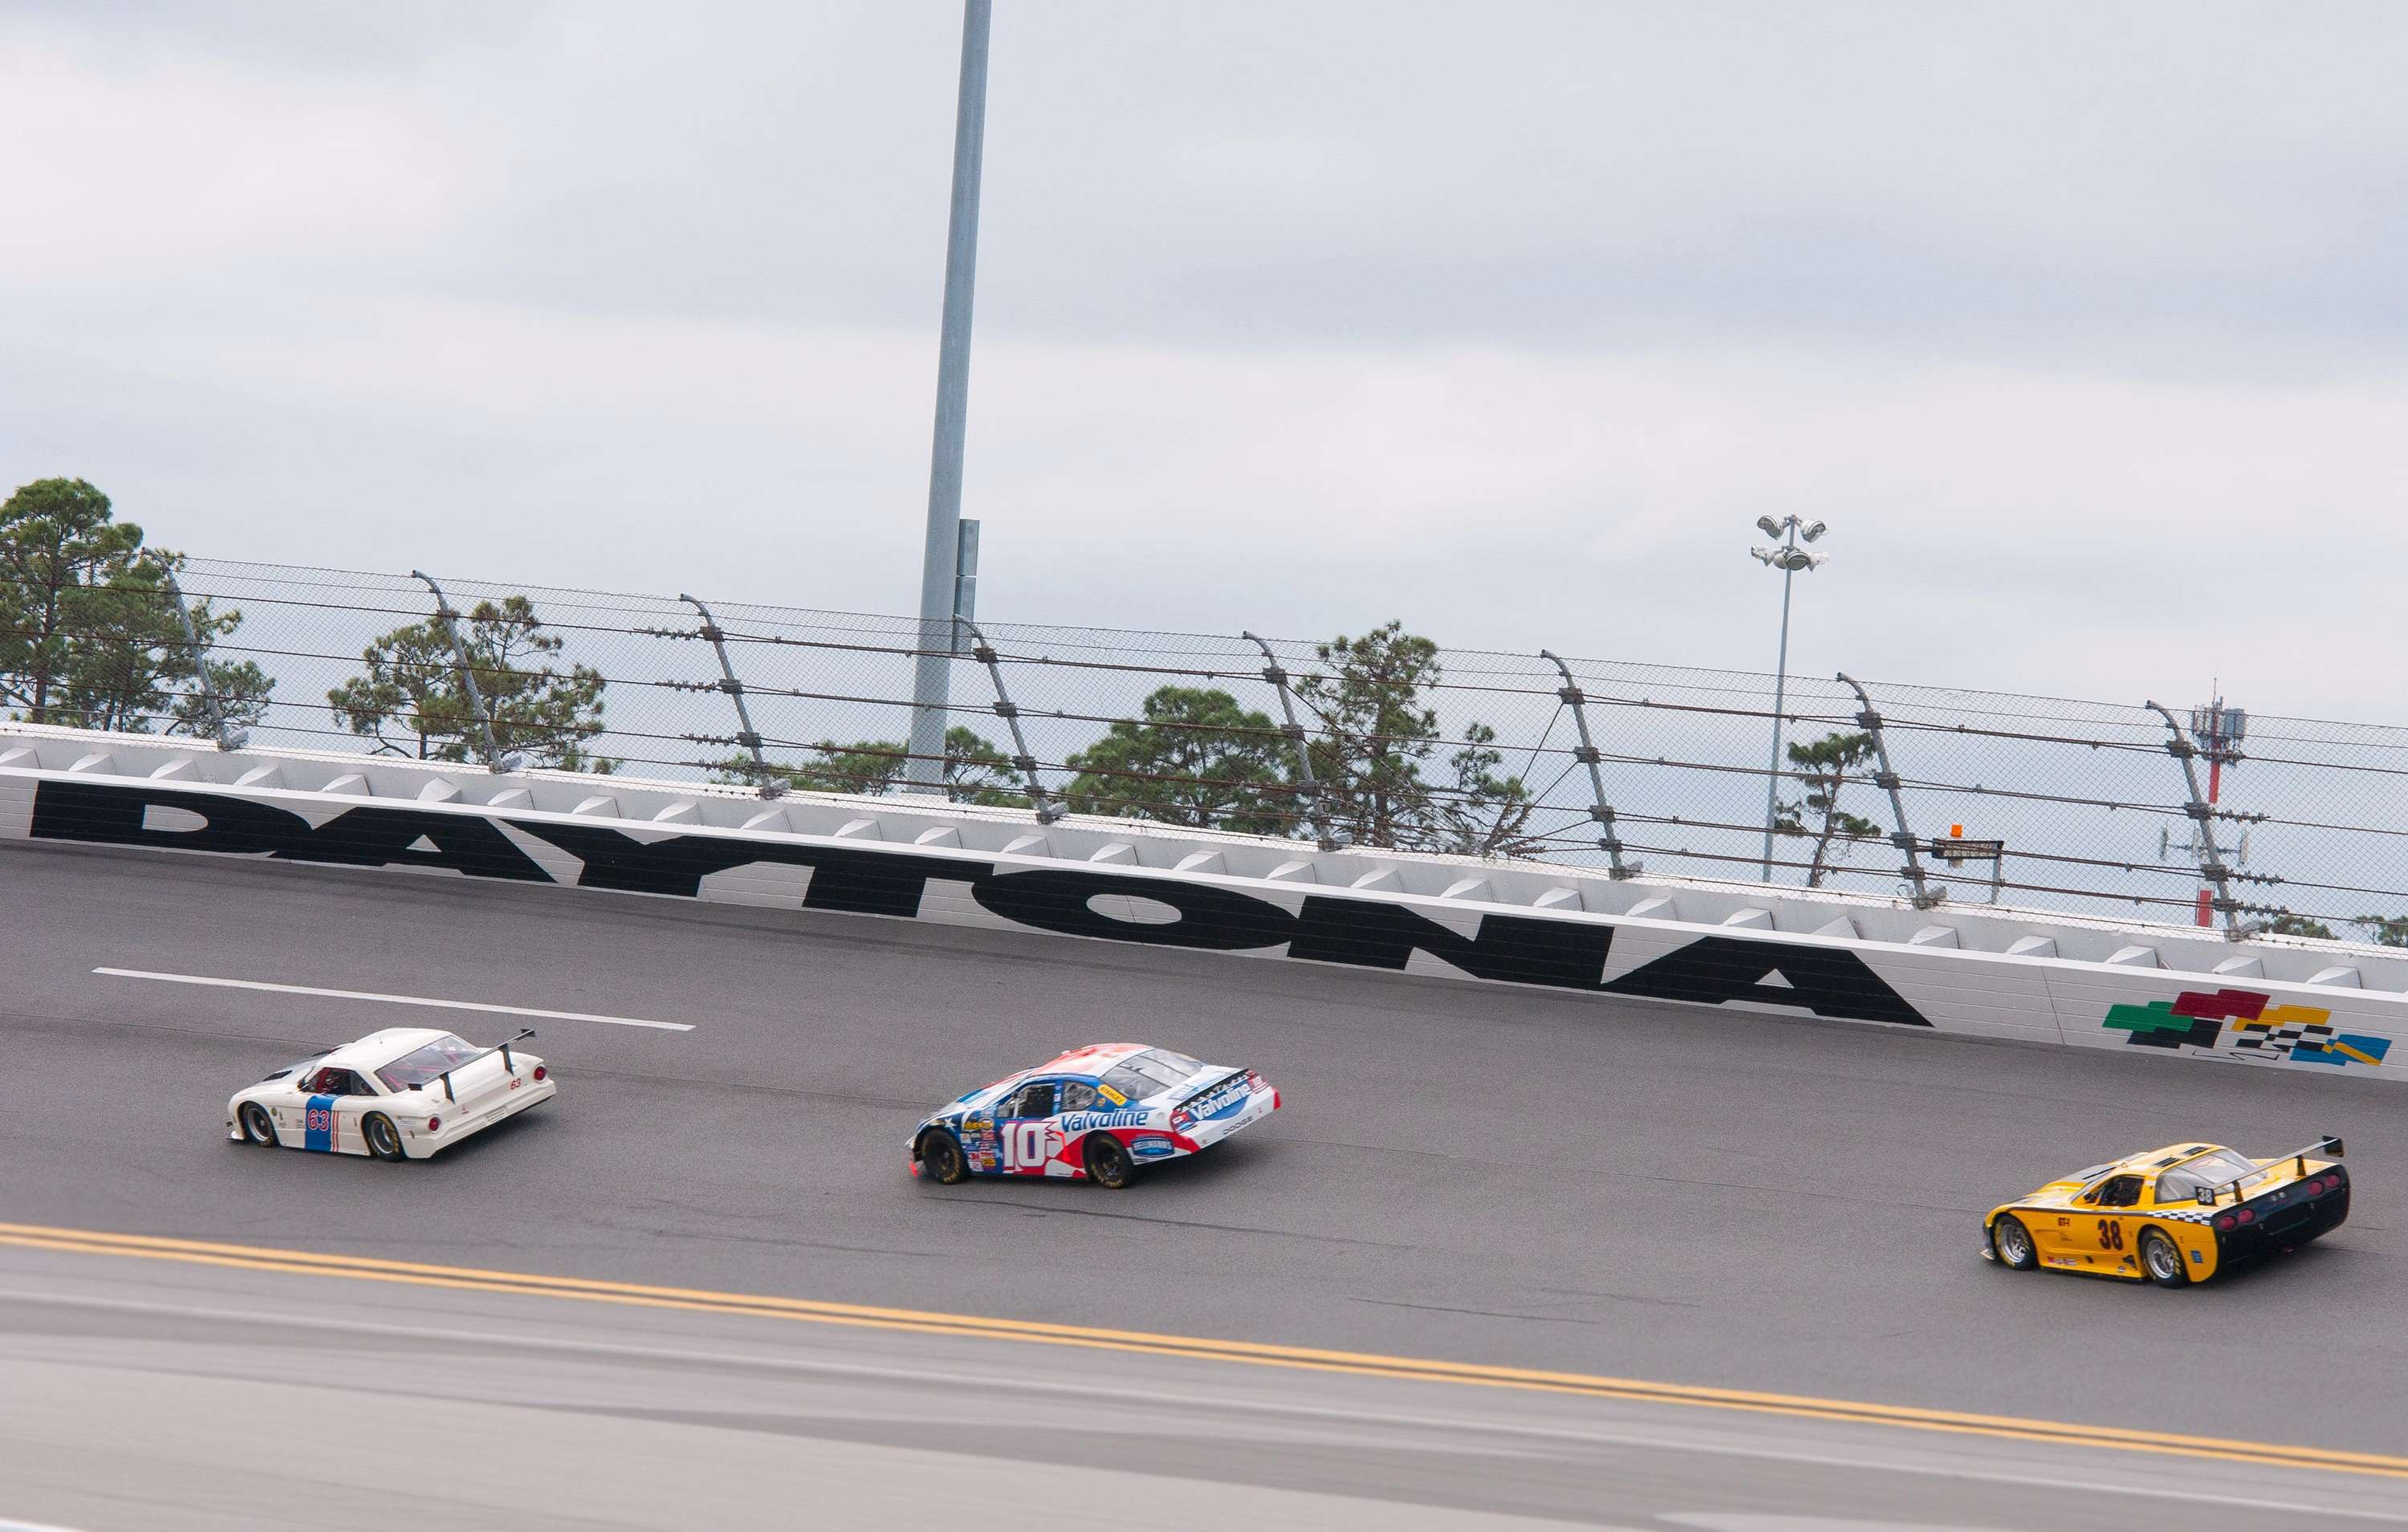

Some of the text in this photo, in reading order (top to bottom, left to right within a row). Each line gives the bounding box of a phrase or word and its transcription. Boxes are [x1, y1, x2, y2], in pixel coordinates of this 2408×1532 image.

[30, 780, 1935, 1027] DAYTONA
[510, 1078, 521, 1090] 63
[1189, 1083, 1251, 1120] Valvoline
[308, 1109, 329, 1131] 63
[1062, 1108, 1149, 1132] Valvoline
[1223, 1115, 1253, 1135] DODGE
[1000, 1120, 1047, 1171] 10
[2198, 1188, 2214, 1204] 38
[2098, 1219, 2124, 1251] 38
